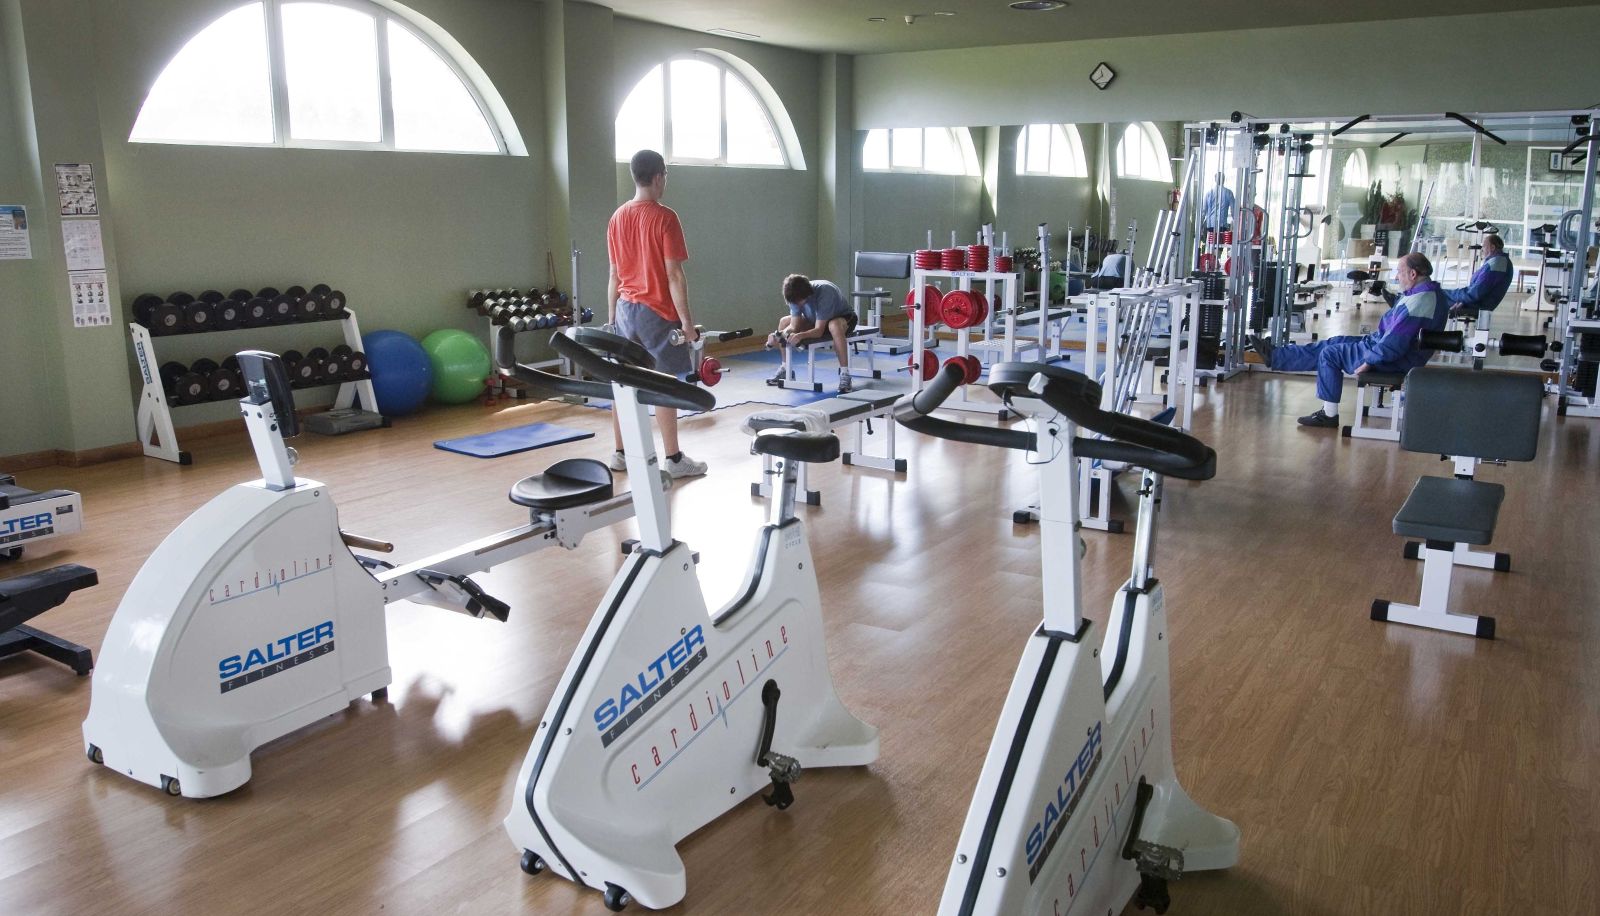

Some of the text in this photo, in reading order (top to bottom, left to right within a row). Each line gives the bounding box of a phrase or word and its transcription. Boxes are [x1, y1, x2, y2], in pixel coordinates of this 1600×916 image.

[209, 553, 333, 602] cardioline
[219, 620, 334, 679] SALTER
[226, 643, 332, 691] FITNESS
[594, 624, 704, 731] SALTER
[609, 652, 705, 739] FITNESS
[631, 625, 788, 785] cardioline
[1026, 720, 1102, 865] SALTER
